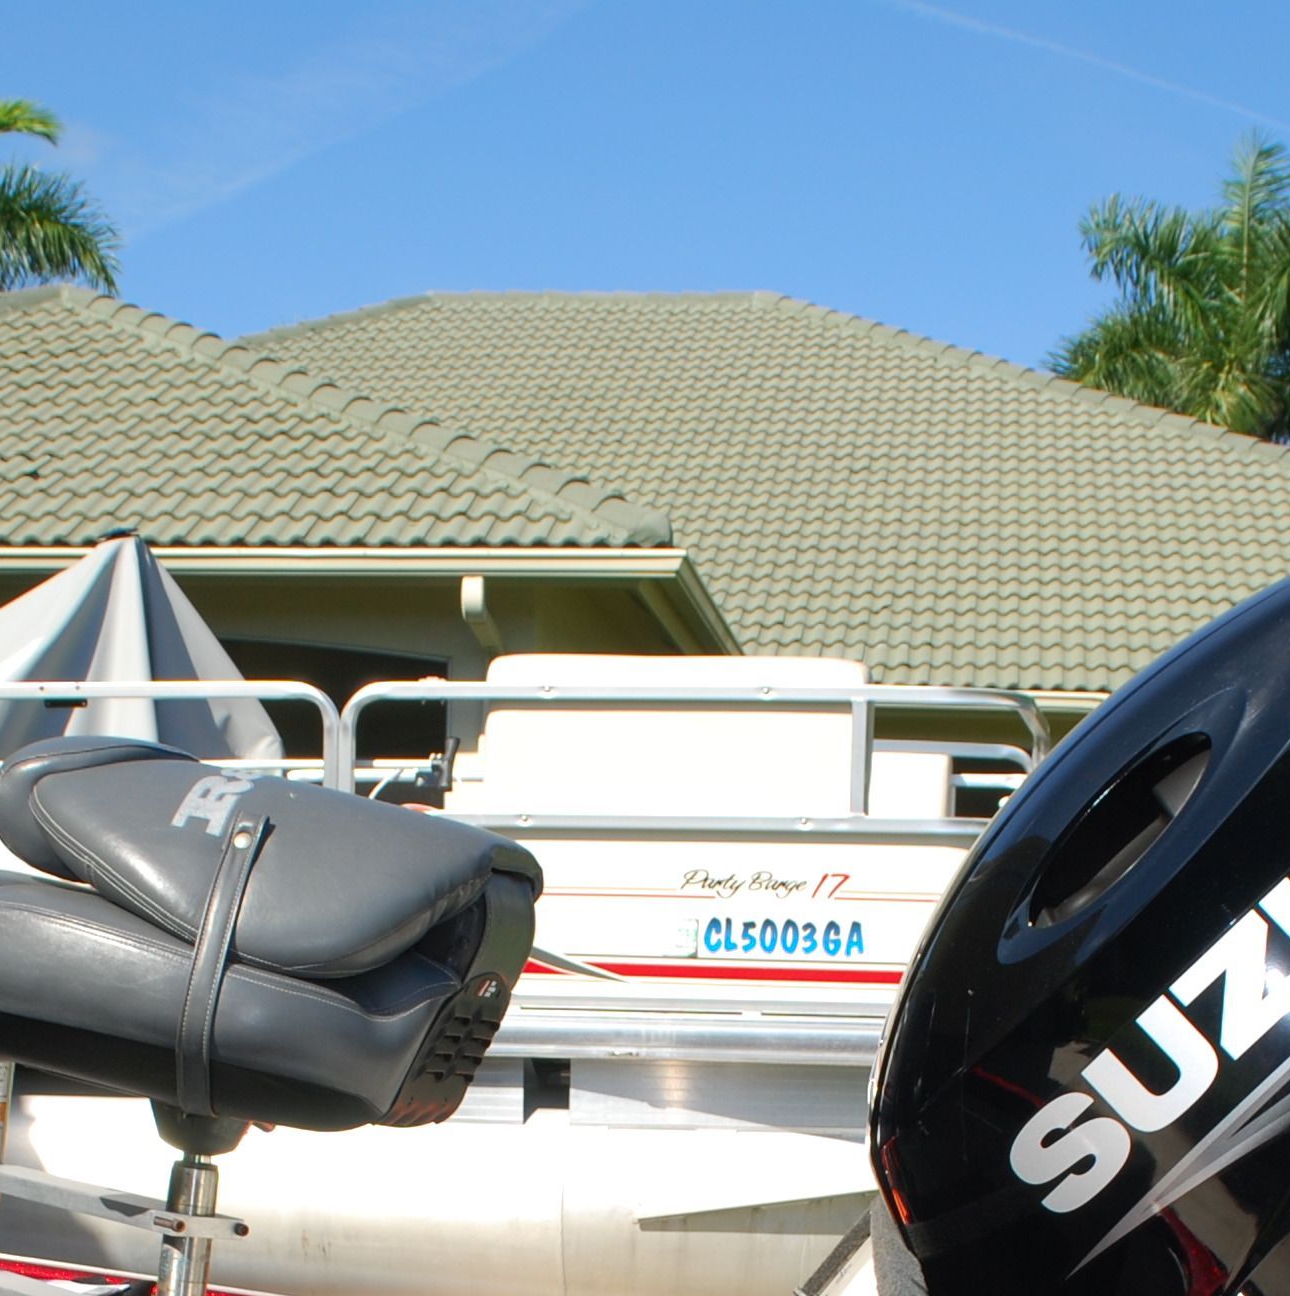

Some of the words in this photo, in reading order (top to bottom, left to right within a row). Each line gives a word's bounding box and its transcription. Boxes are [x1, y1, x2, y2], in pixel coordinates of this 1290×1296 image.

[681, 869, 746, 899] Party
[748, 871, 807, 899] Barge
[811, 873, 851, 899] 17
[703, 917, 865, 957] CL5003GA
